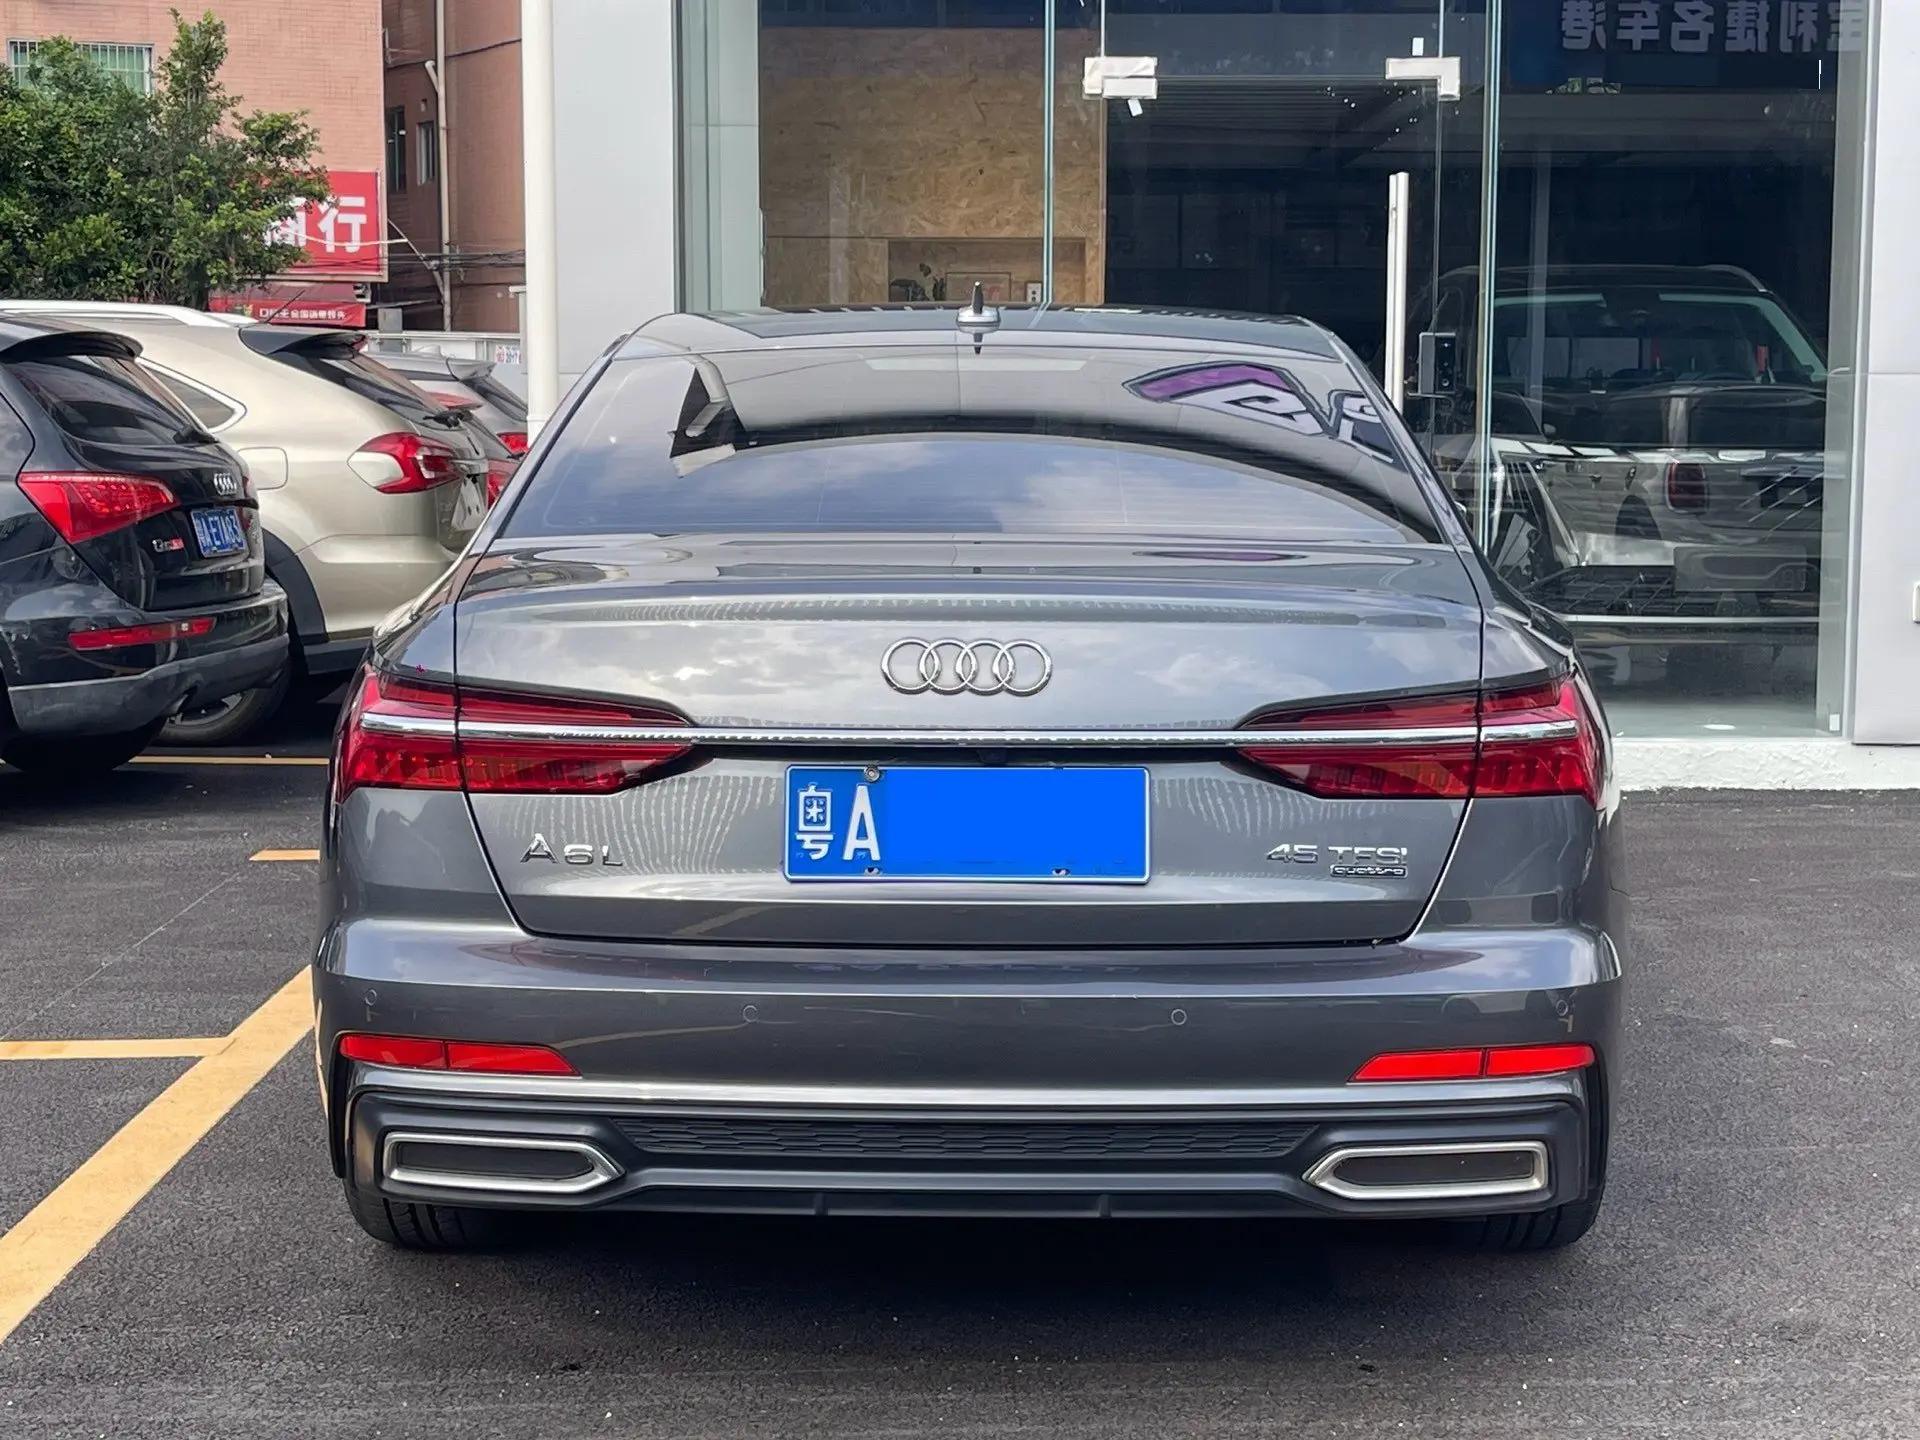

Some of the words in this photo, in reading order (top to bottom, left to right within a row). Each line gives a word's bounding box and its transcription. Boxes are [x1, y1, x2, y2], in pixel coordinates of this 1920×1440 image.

[795, 783, 881, 862] 粤A
[520, 832, 624, 866] A6L
[1266, 843, 1319, 864] 45
[1328, 846, 1409, 865] TFSI
